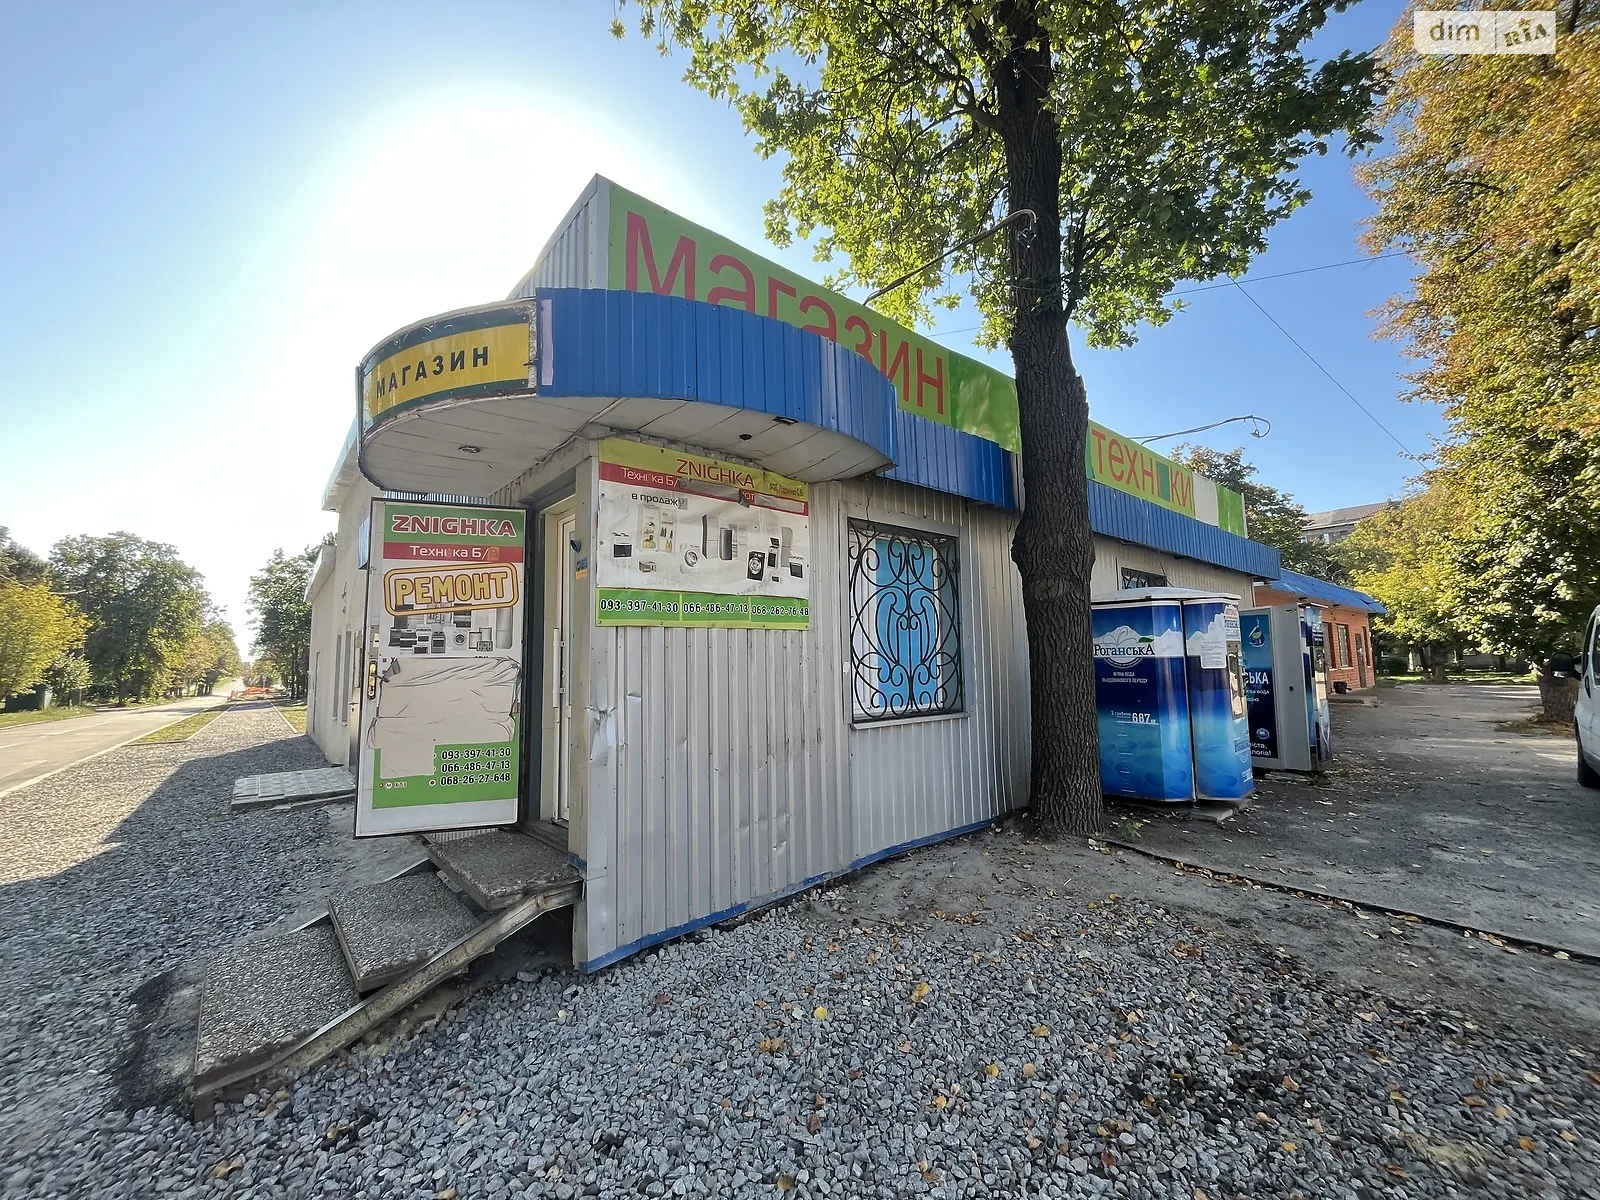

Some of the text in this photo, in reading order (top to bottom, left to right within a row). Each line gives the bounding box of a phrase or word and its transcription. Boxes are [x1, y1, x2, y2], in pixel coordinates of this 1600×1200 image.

[376, 346, 489, 400] МАГАЗИН
[676, 458, 755, 489] ZNIGHKA
[392, 514, 517, 537] ZNIGHKA
[394, 571, 508, 607] РЕМОНТ
[600, 598, 679, 614] 093-397-41-30
[683, 602, 749, 614] 066-486-47-13
[1132, 712, 1151, 724] 687
[441, 747, 511, 760] 093-397-41-30
[441, 760, 511, 773] 066-486-47-13
[440, 772, 511, 786] 068-26-27-648
